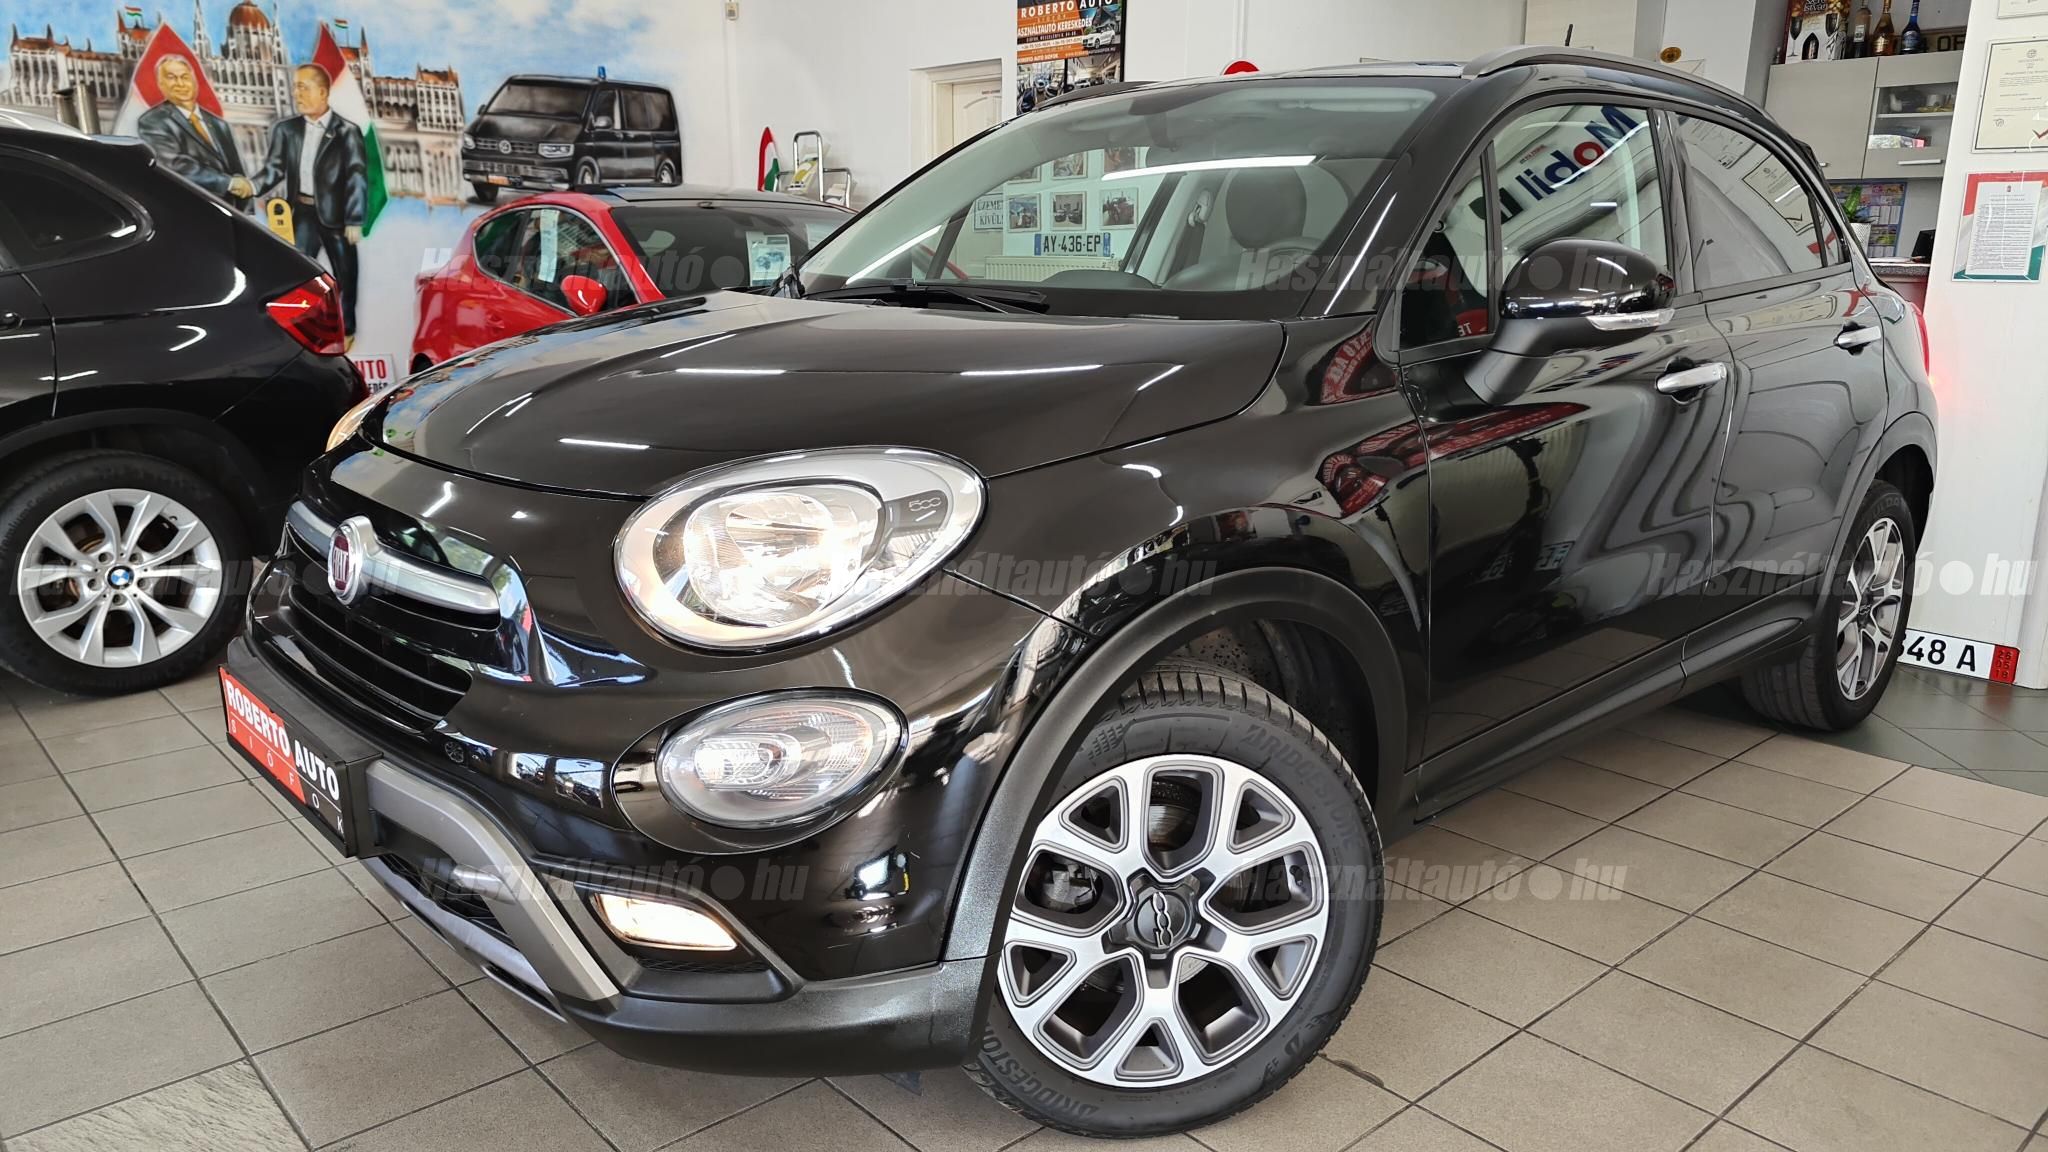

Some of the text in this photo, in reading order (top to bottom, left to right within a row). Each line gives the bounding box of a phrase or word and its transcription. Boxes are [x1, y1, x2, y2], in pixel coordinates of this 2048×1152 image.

[1021, 1, 1075, 18] ROBERTO
[332, 546, 349, 583] FIAT
[1956, 644, 1976, 672] A
[226, 679, 340, 801] ROBERTO AUTO
